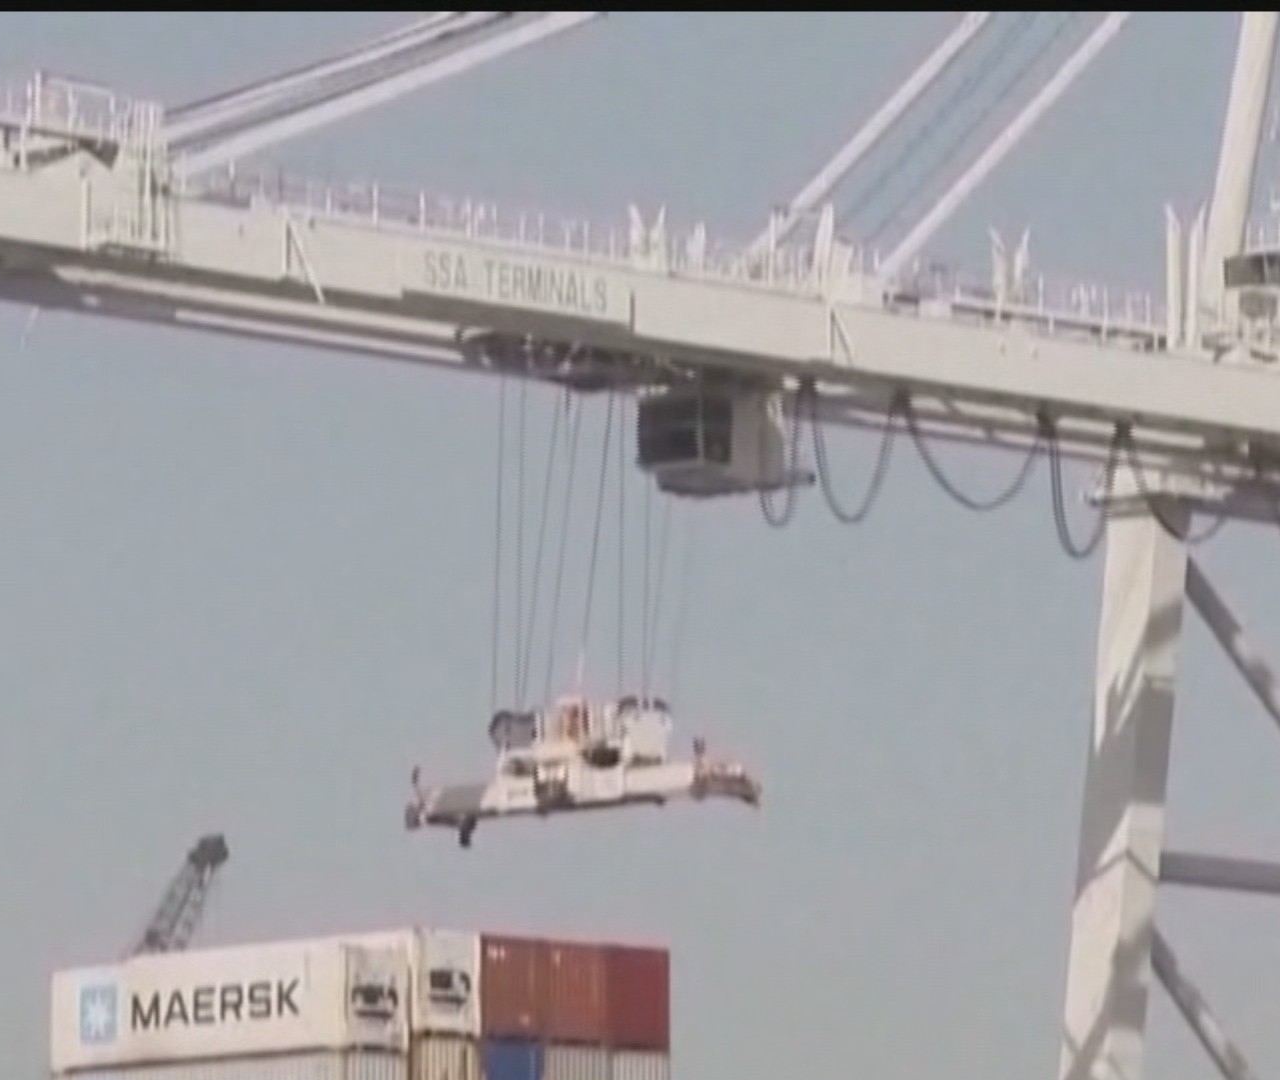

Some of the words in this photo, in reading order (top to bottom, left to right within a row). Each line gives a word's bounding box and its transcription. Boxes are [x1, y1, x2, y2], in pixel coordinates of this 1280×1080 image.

[423, 250, 468, 291] SSA
[482, 259, 608, 313] TERMINALS
[131, 978, 300, 1031] MAERSK
